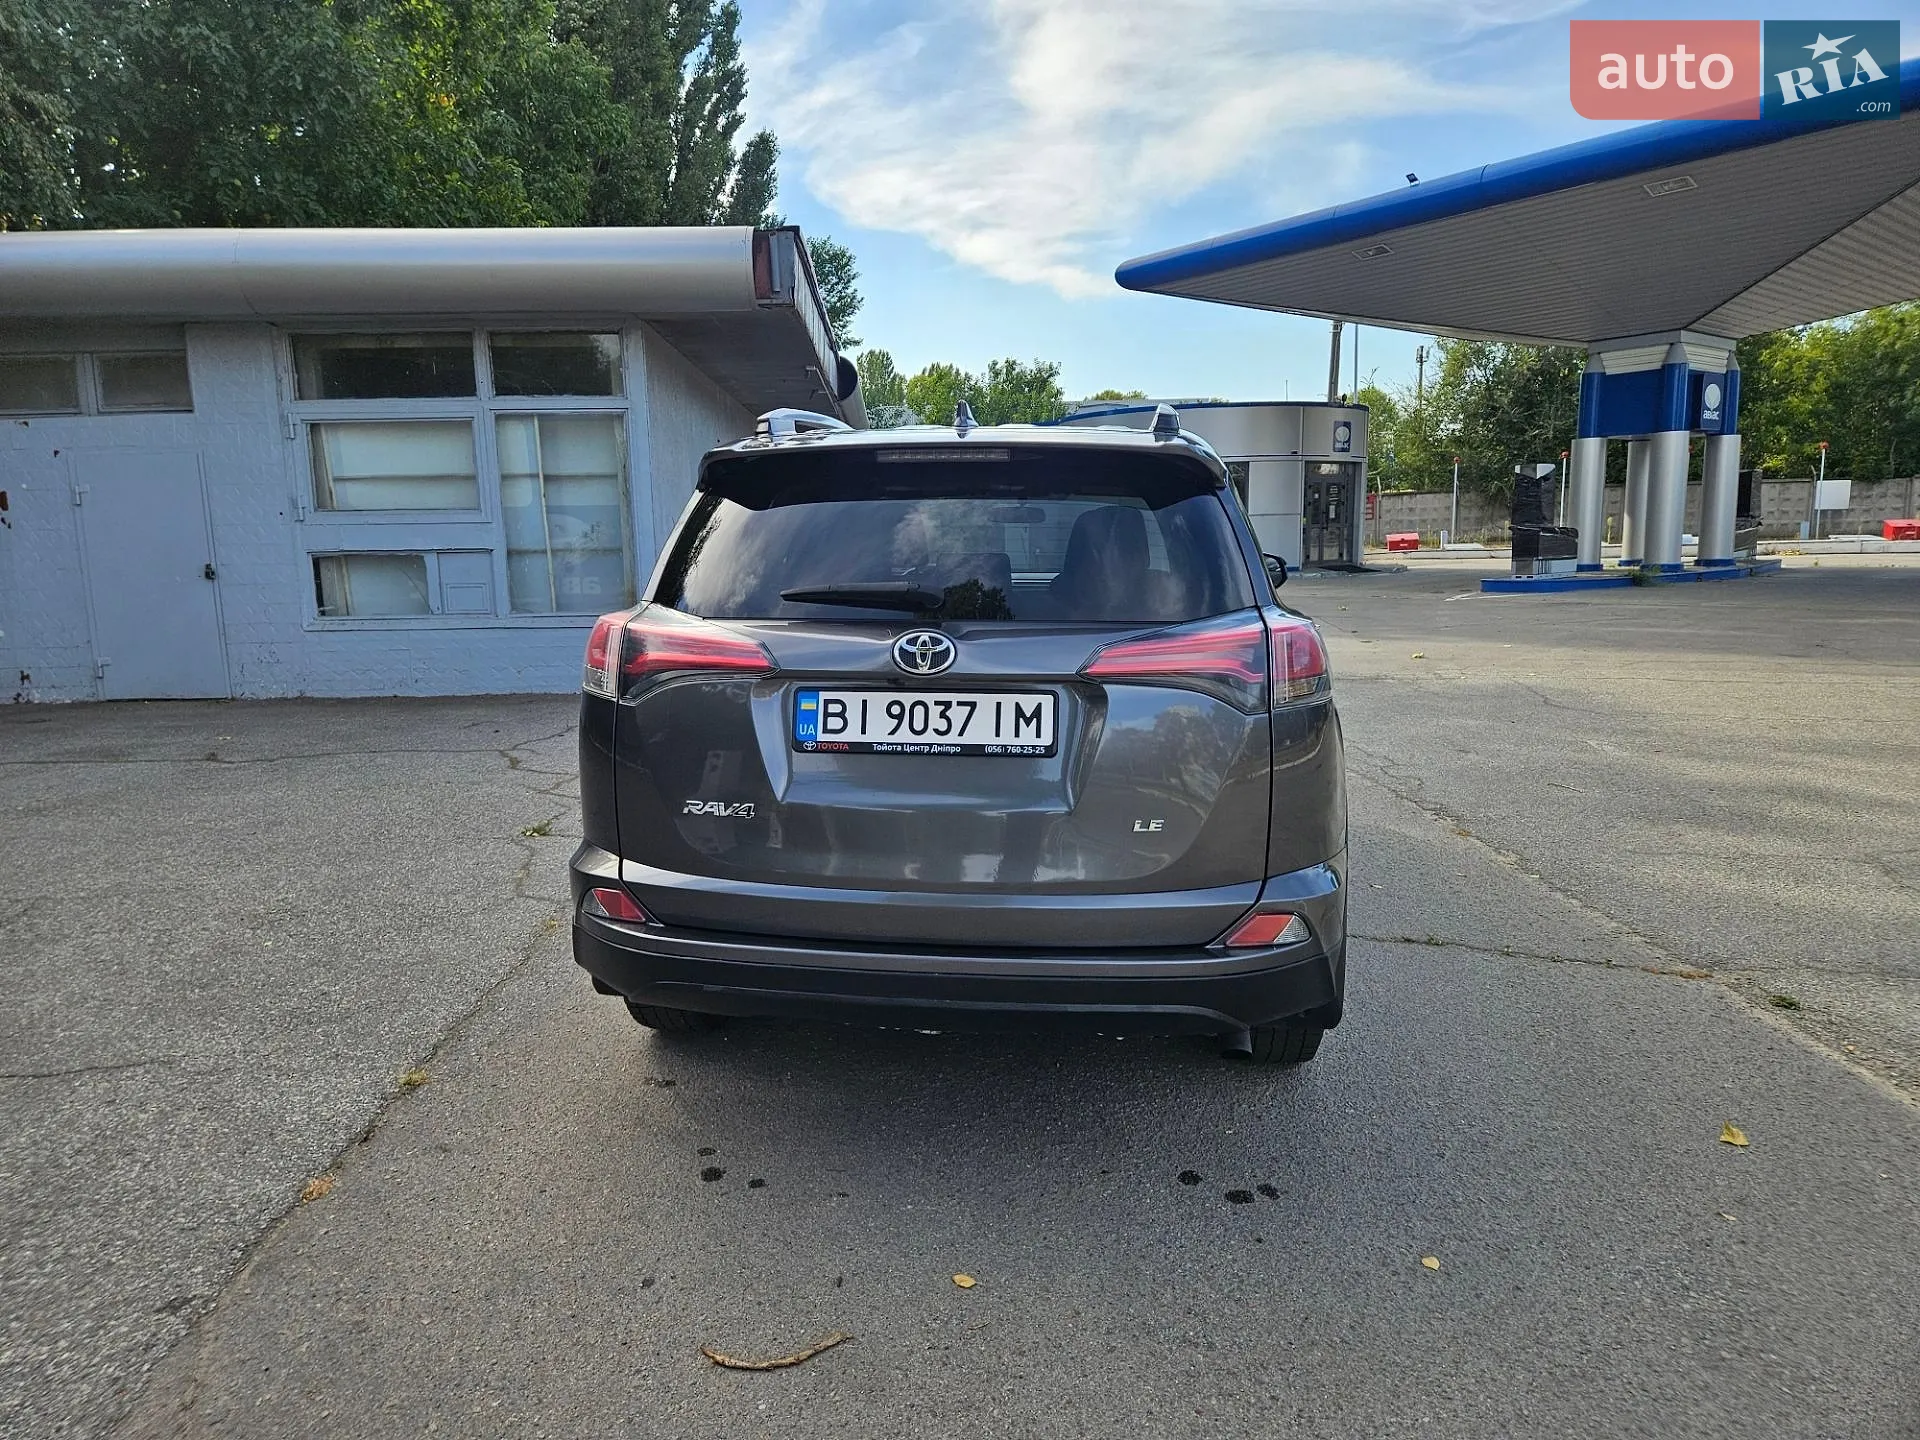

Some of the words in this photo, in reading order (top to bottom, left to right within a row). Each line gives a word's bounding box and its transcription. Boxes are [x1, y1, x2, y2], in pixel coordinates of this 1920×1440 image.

[822, 698, 868, 735] BI
[886, 699, 978, 737] 9037
[995, 701, 1043, 739] IM
[799, 723, 816, 735] UA
[817, 743, 849, 751] TOYOTA
[872, 743, 902, 751] Тойота
[903, 744, 930, 753] Центр
[930, 745, 961, 754] Дніпро
[1007, 746, 1046, 754] 760-25-25
[683, 801, 756, 819] RAV4
[1133, 819, 1165, 832] LE
